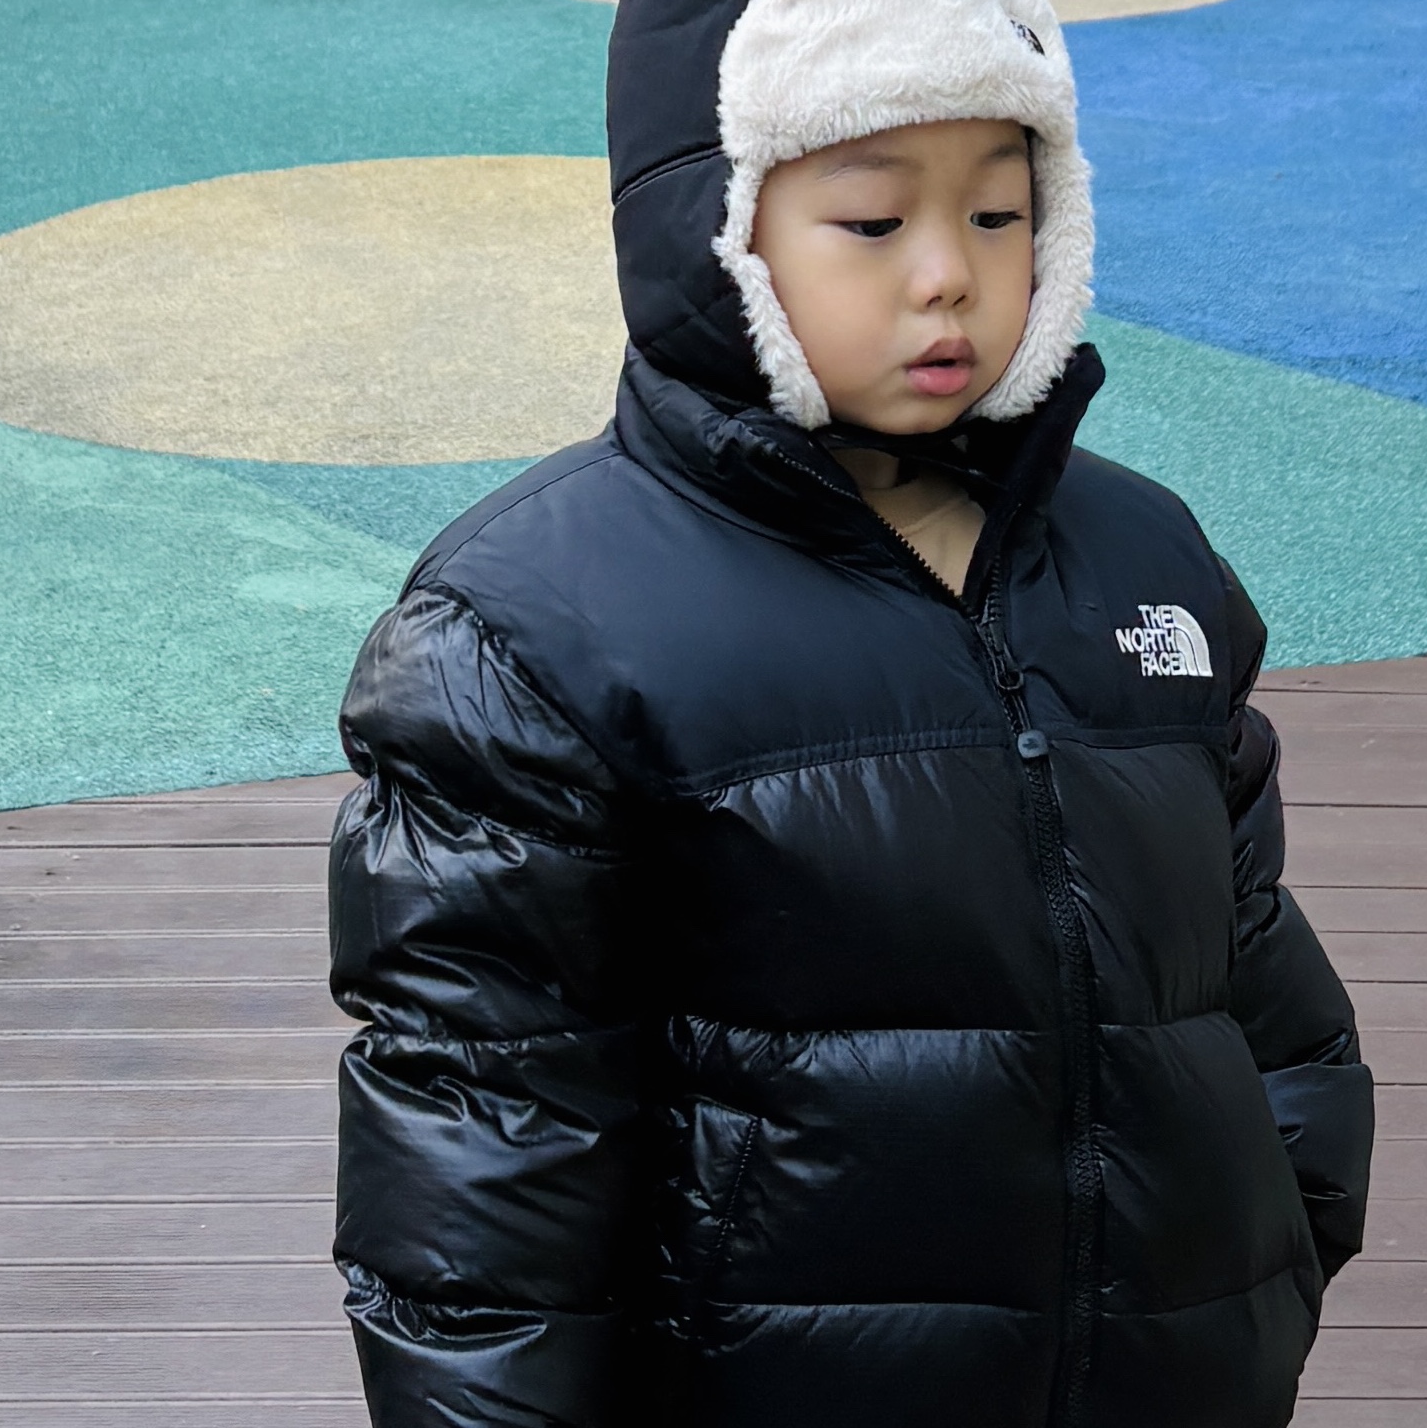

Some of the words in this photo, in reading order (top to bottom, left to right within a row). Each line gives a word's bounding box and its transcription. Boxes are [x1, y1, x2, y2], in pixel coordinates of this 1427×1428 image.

[1137, 604, 1175, 629] THE
[1114, 627, 1178, 653] NORTH
[1140, 652, 1180, 677] FACE
